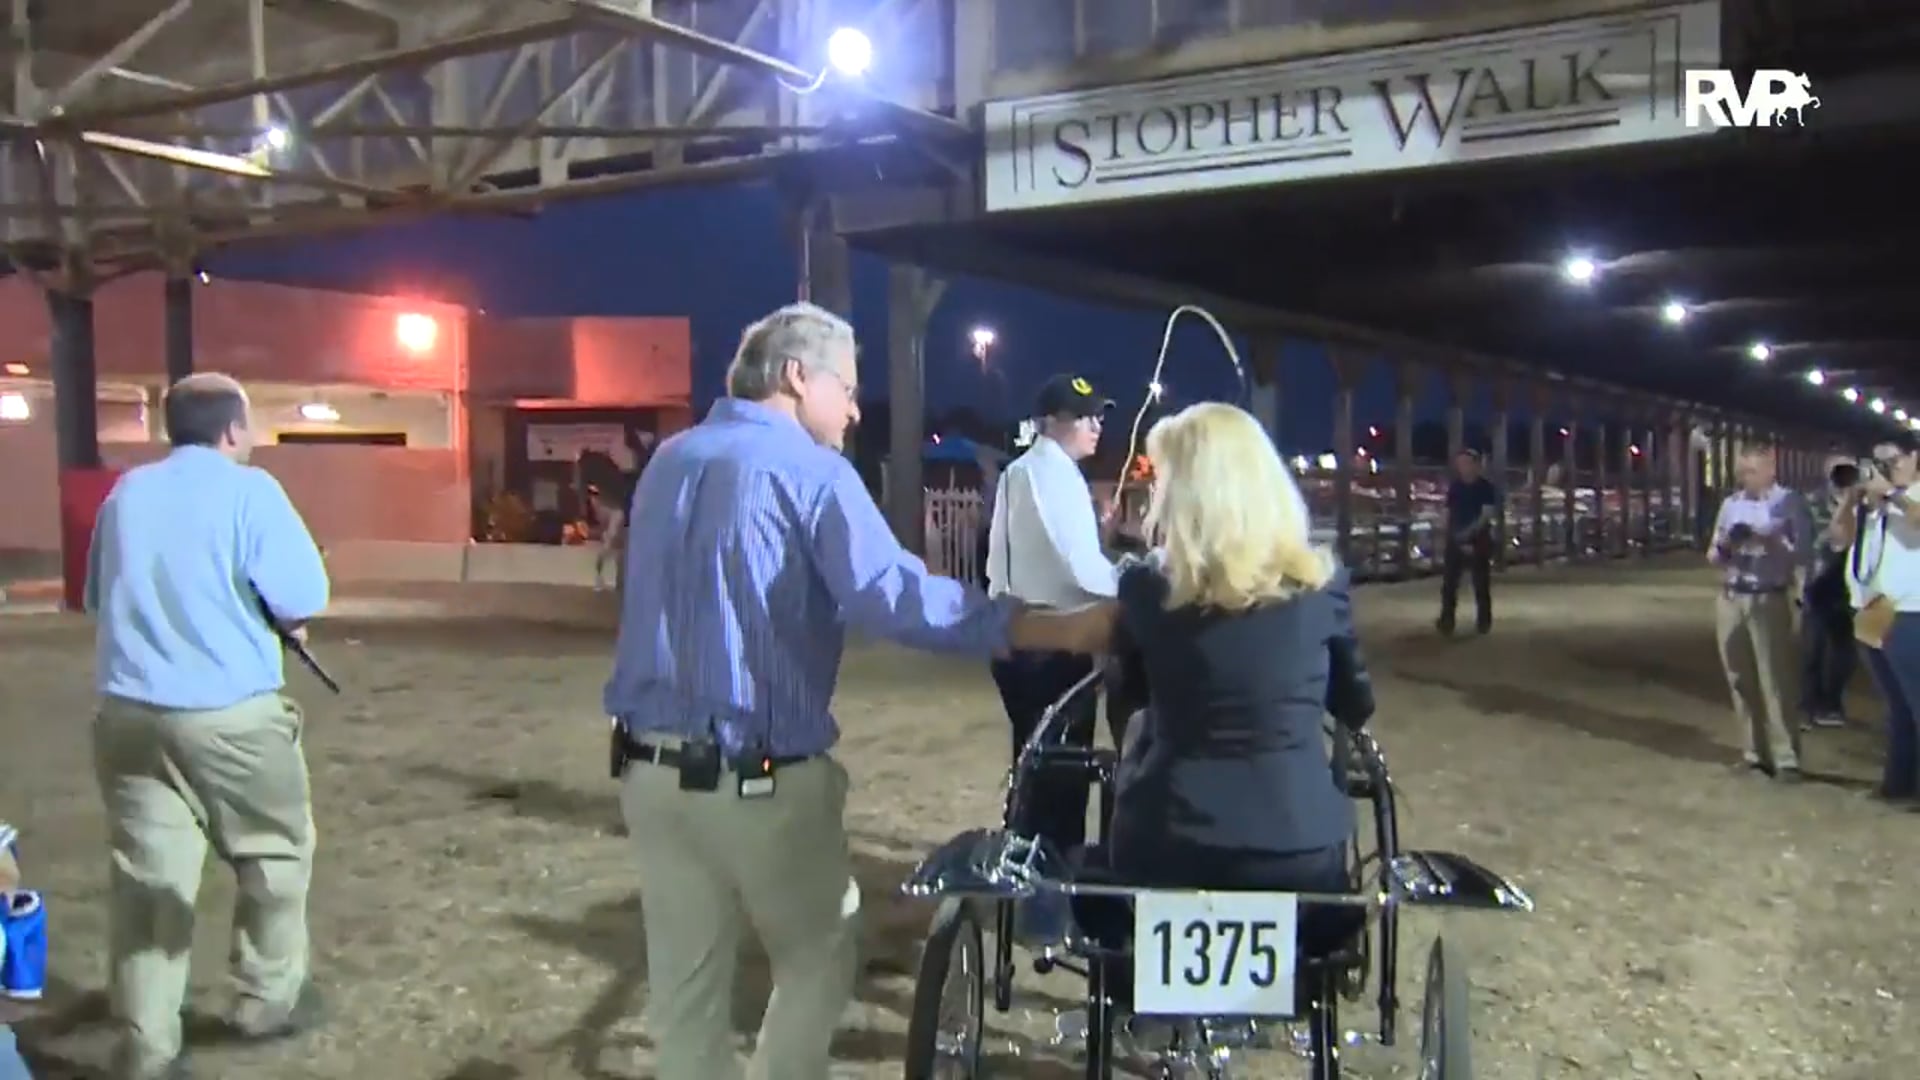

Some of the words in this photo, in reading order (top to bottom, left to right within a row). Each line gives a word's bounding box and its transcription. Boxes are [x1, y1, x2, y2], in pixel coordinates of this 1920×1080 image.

[1052, 86, 1349, 188] STOPHER
[1370, 48, 1621, 152] WALK
[1153, 920, 1277, 987] 1375
